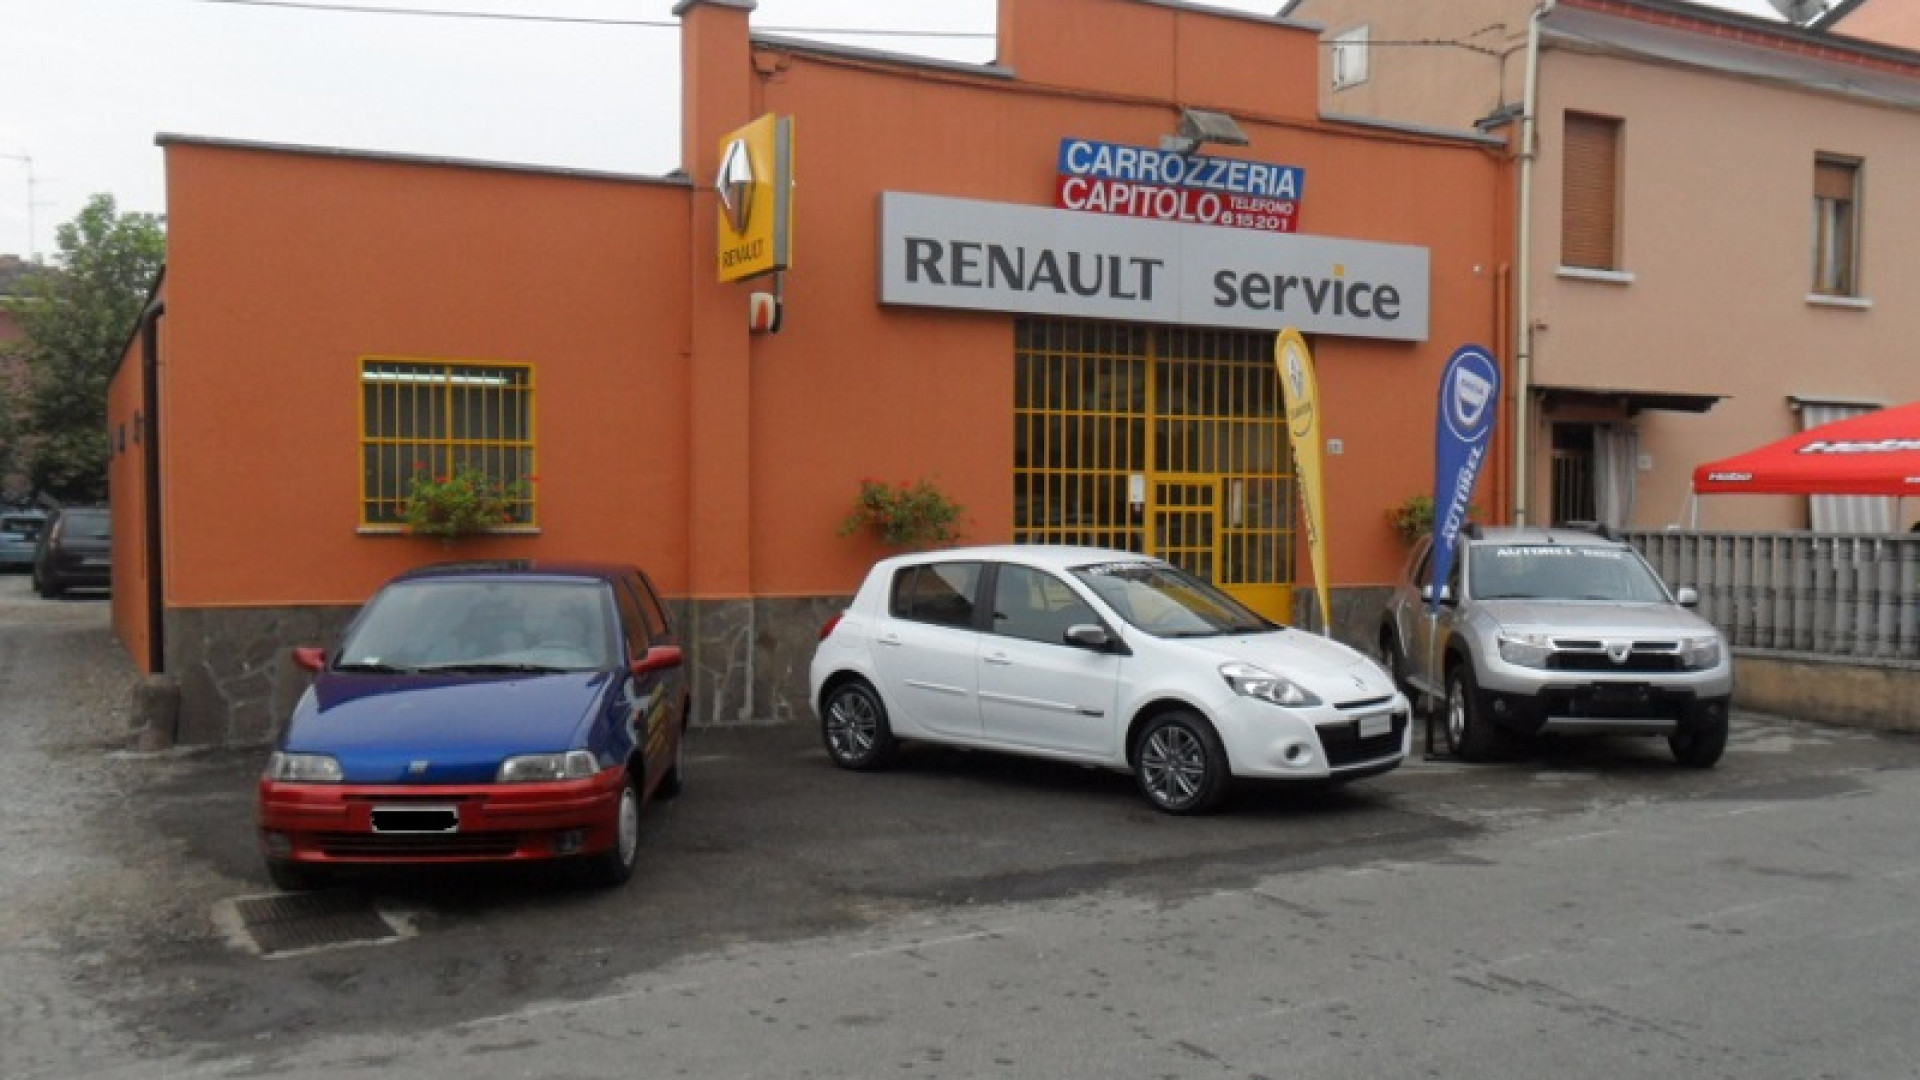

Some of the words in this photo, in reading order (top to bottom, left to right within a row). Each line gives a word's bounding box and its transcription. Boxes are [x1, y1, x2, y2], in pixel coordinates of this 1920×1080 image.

[1067, 141, 1296, 199] CARROZZERIA
[1062, 177, 1222, 223] CAPITOLO
[1230, 196, 1293, 215] TELEFONO
[721, 239, 764, 267] RENAULT
[904, 237, 1165, 302] RENAULT
[1213, 263, 1400, 320] service
